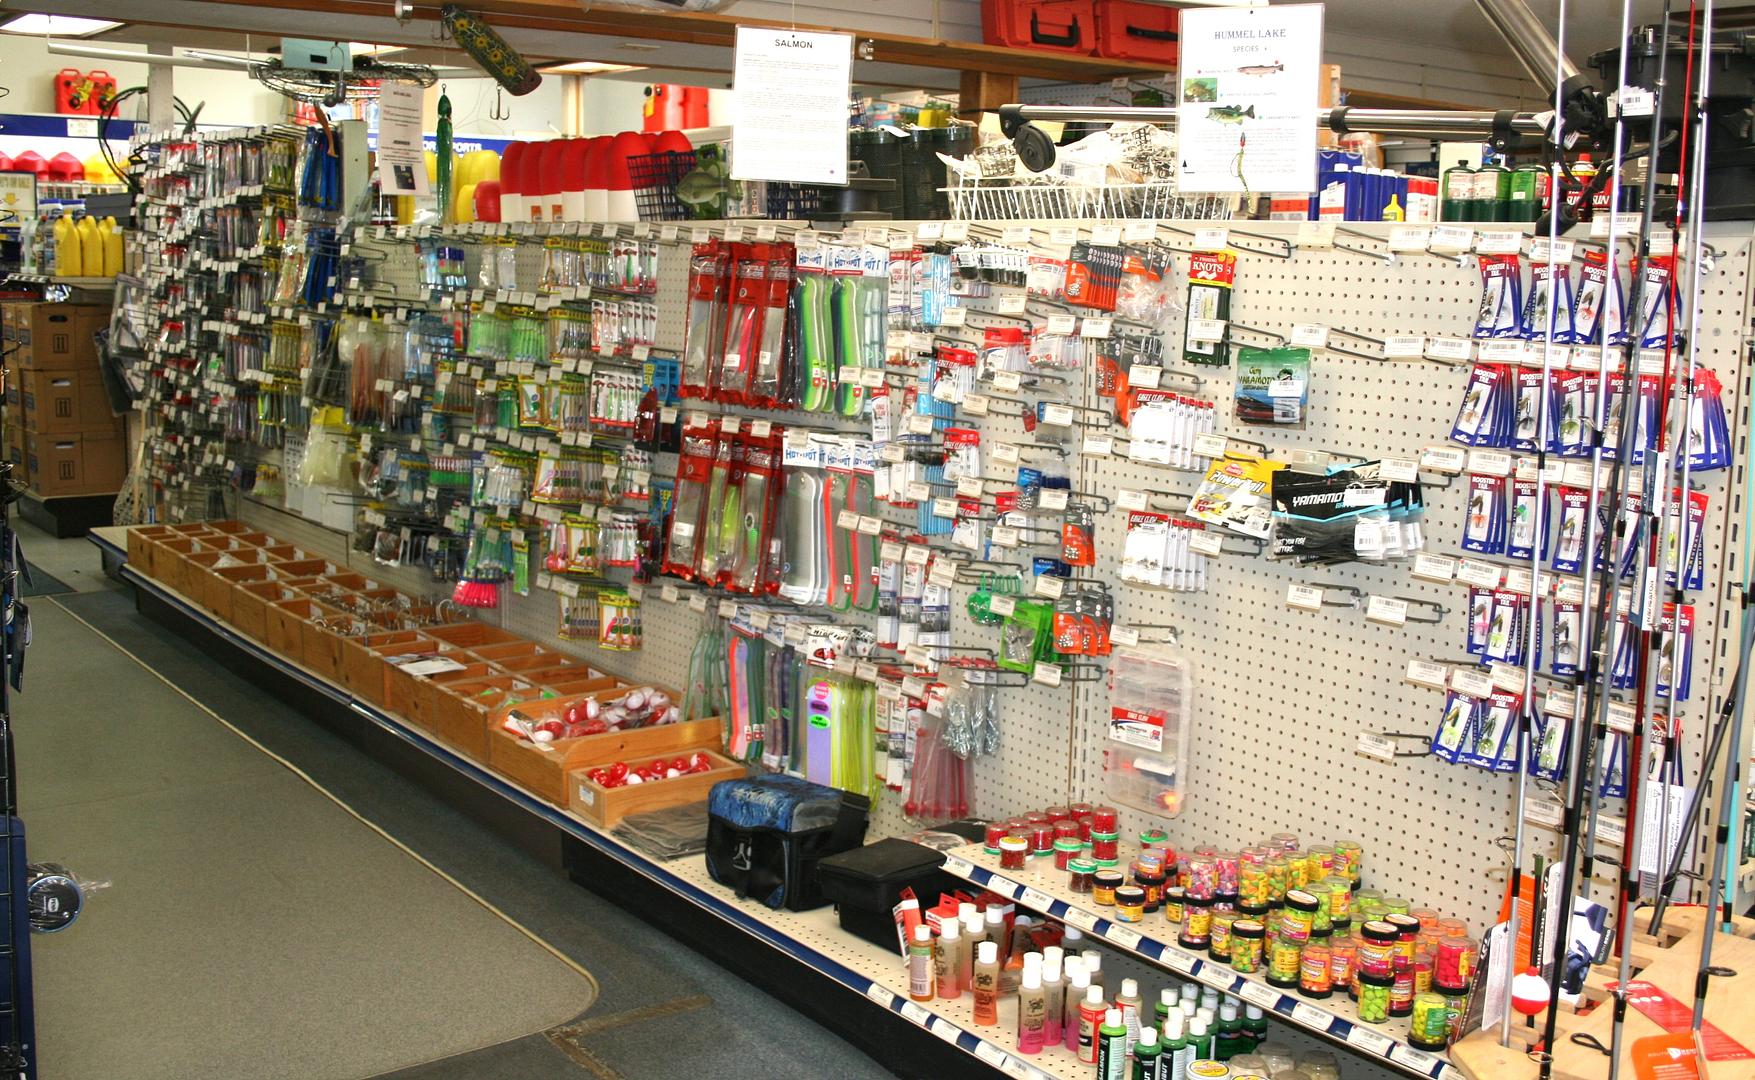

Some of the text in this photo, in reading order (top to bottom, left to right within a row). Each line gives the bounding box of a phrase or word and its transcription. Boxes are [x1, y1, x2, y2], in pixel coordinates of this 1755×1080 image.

[1214, 28, 1286, 40] HUMMEL LAKE
[774, 39, 813, 49] SALMON
[1232, 45, 1259, 53] SPECIES
[452, 142, 482, 152] PORTS
[1192, 261, 1224, 273] KNOTS
[1584, 266, 1607, 276] ROOSTE
[1647, 267, 1668, 277] OOSTER
[1474, 368, 1498, 380] ROOSTER
[1478, 375, 1489, 383] TAIL
[1562, 376, 1583, 387] ROOSTER
[785, 449, 799, 459] HOT
[1472, 476, 1496, 484] ROOSTER
[1293, 493, 1346, 507] YAMAMOT
[1564, 494, 1588, 502] ROOSTER
[1495, 593, 1517, 601] ROOSTER
[1491, 693, 1515, 702] ROOSTER
